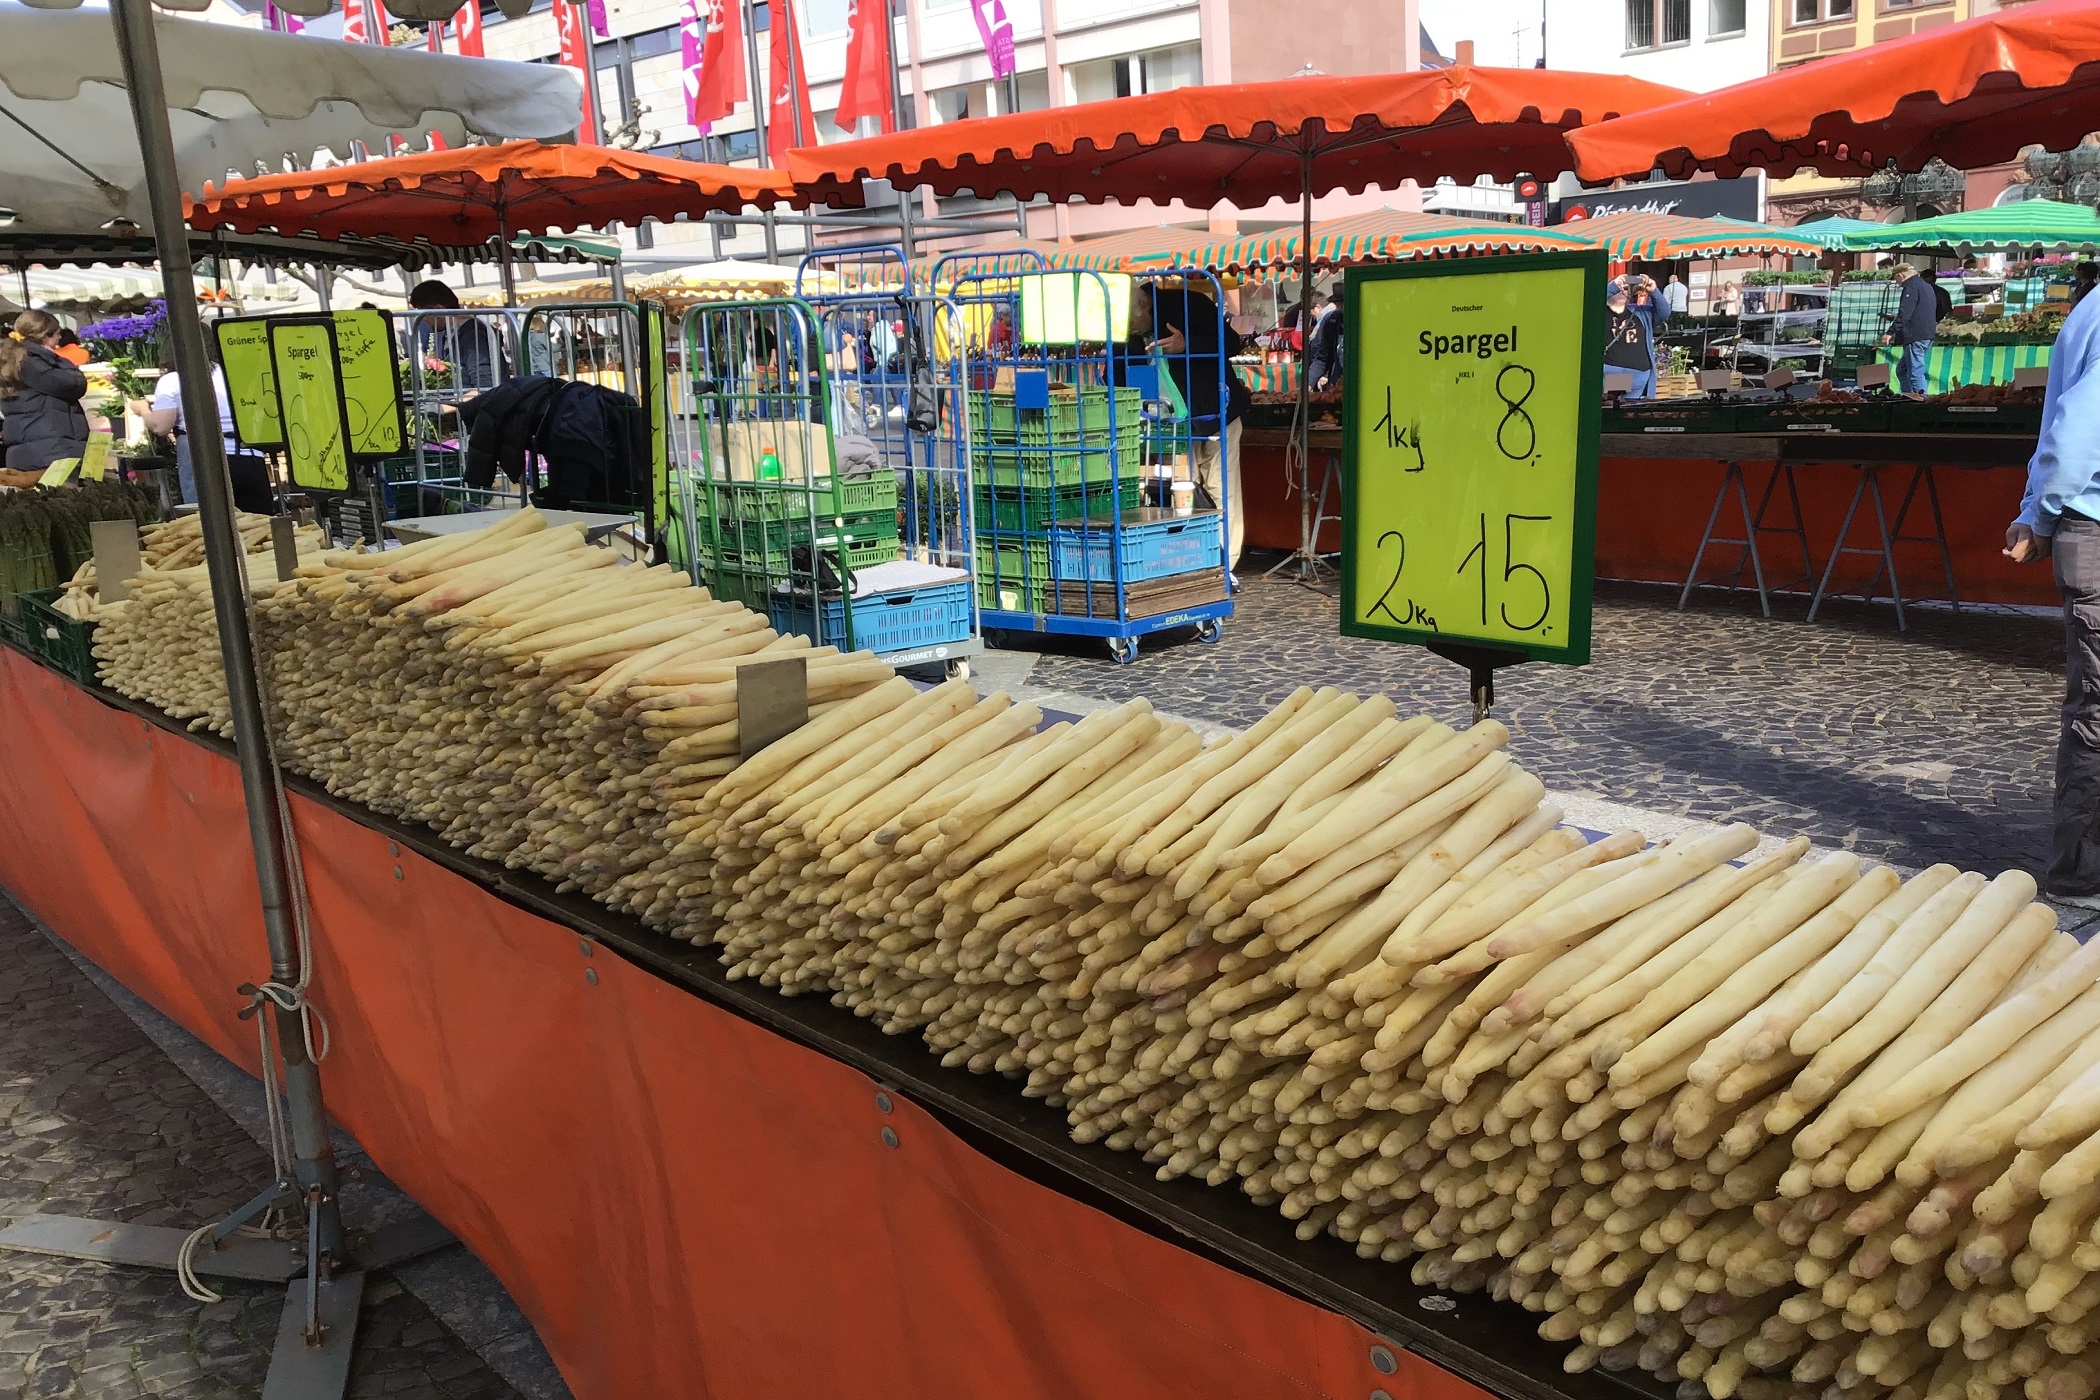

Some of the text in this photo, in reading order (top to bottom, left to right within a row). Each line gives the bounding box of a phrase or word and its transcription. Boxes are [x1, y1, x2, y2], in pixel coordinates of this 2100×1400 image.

[1452, 304, 1483, 312] Deutscher
[227, 336, 256, 346] Grüner
[1419, 326, 1517, 360] Spargel
[287, 345, 318, 360] Spargel
[1165, 613, 1189, 625] EDEKA
